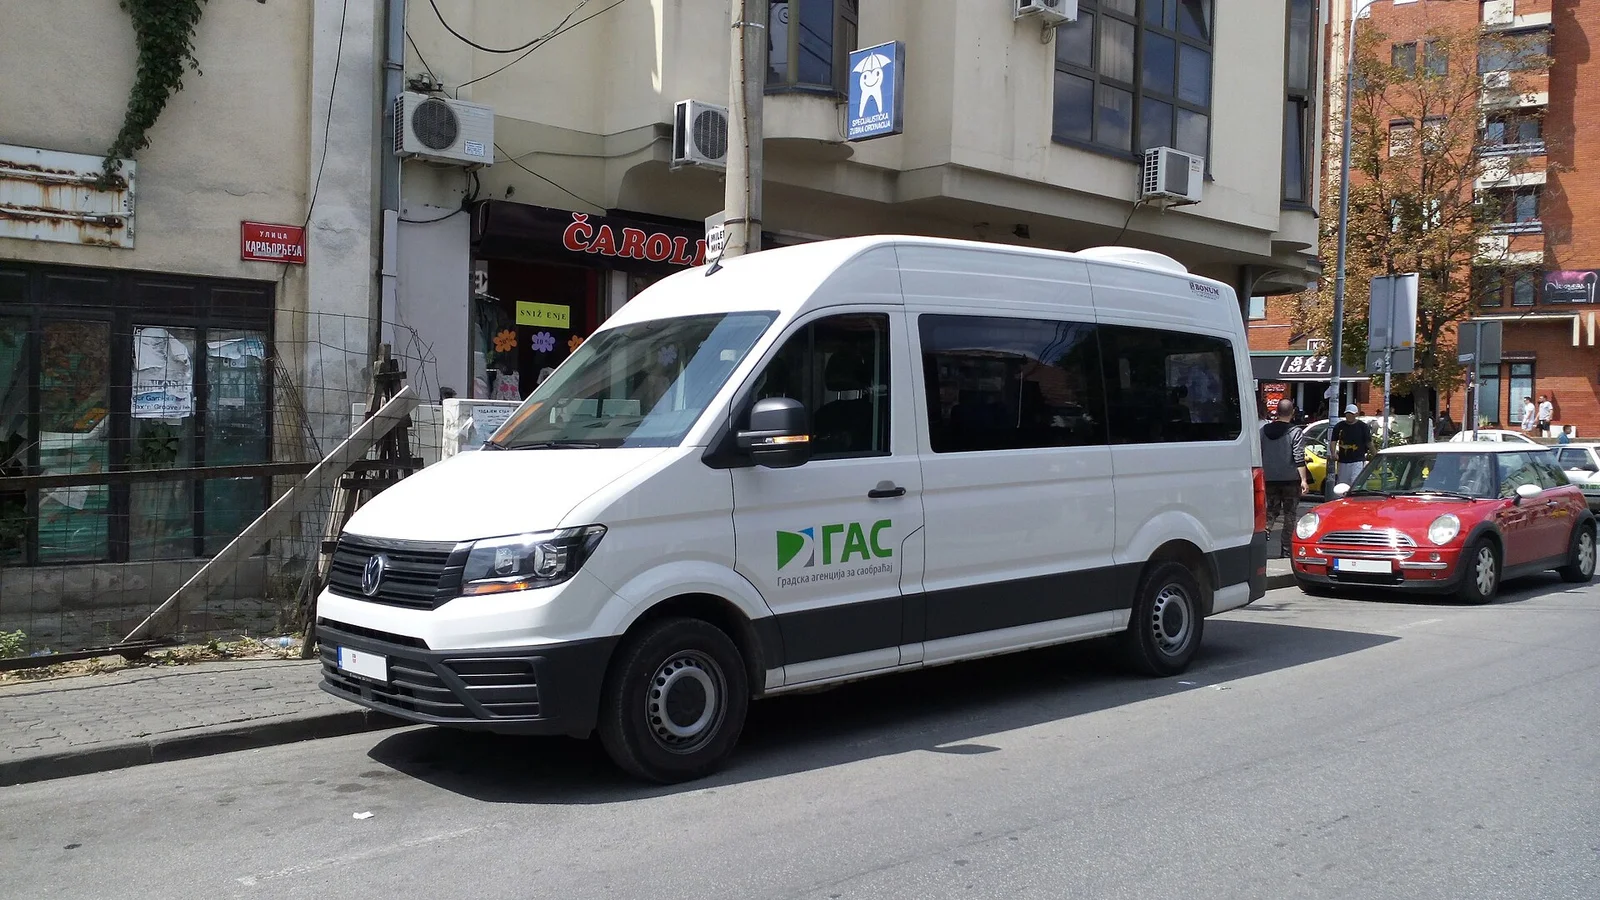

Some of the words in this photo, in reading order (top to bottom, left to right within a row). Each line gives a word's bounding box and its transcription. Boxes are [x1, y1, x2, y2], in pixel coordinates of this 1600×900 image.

[259, 230, 288, 240] УЛИЦА
[245, 240, 303, 257] КАРАЂОРЂЕВА
[520, 309, 542, 318] SNIŽ
[822, 519, 893, 565] ГАС
[777, 574, 810, 588] Градска
[811, 569, 845, 582] агенција
[846, 569, 855, 577] за
[857, 563, 893, 576] саобраћај
